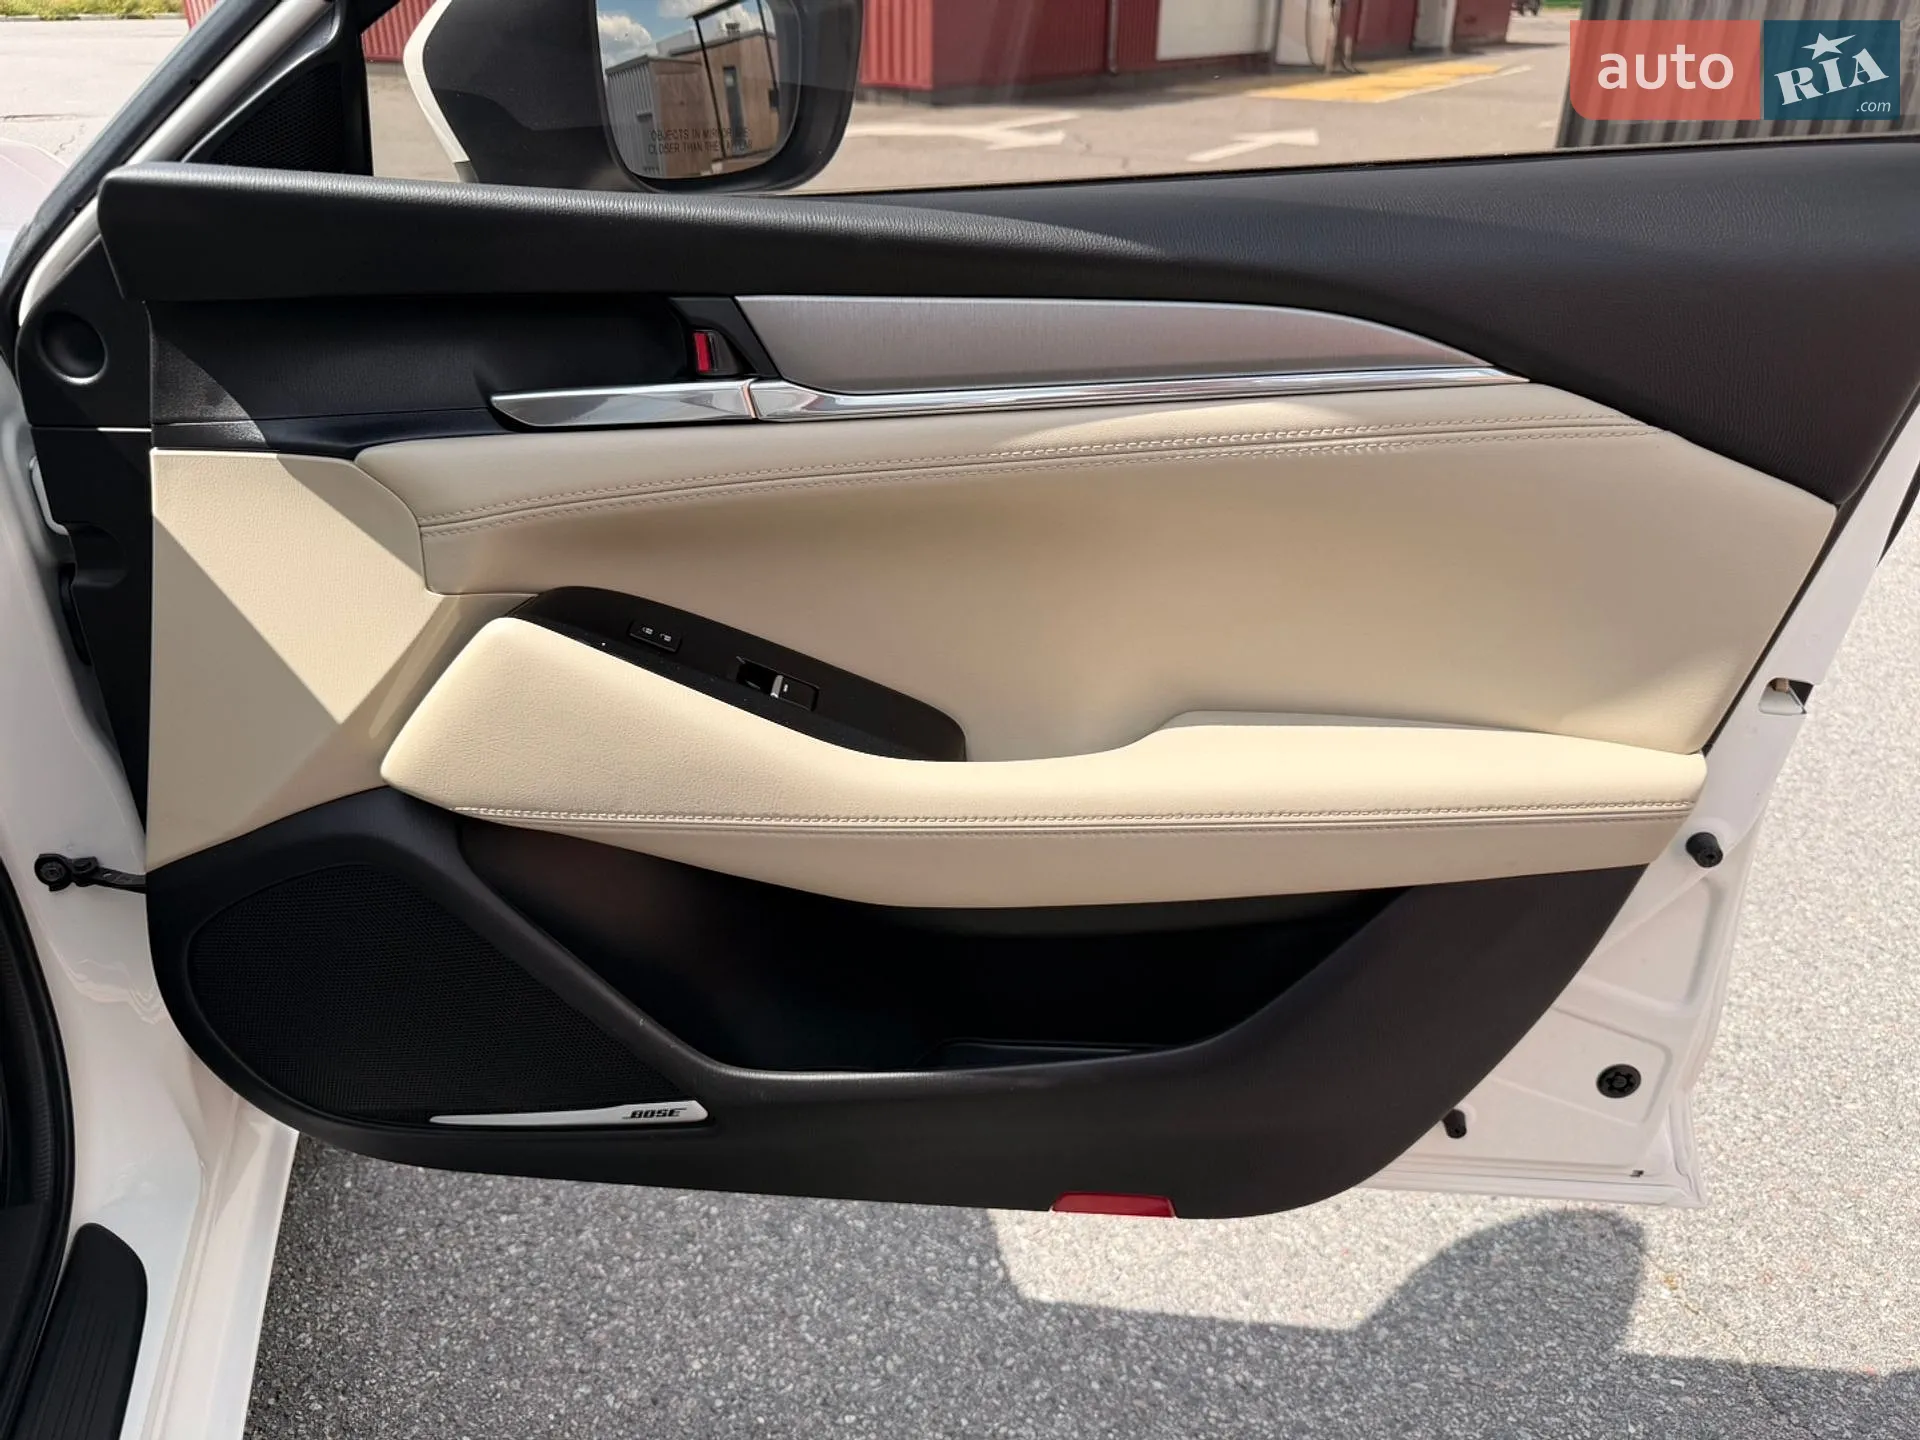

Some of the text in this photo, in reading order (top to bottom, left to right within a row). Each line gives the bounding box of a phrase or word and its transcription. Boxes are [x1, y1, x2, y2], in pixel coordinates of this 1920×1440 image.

[702, 128, 732, 138] MIROR
[703, 140, 723, 151] THE
[622, 1107, 687, 1119] BOSE
